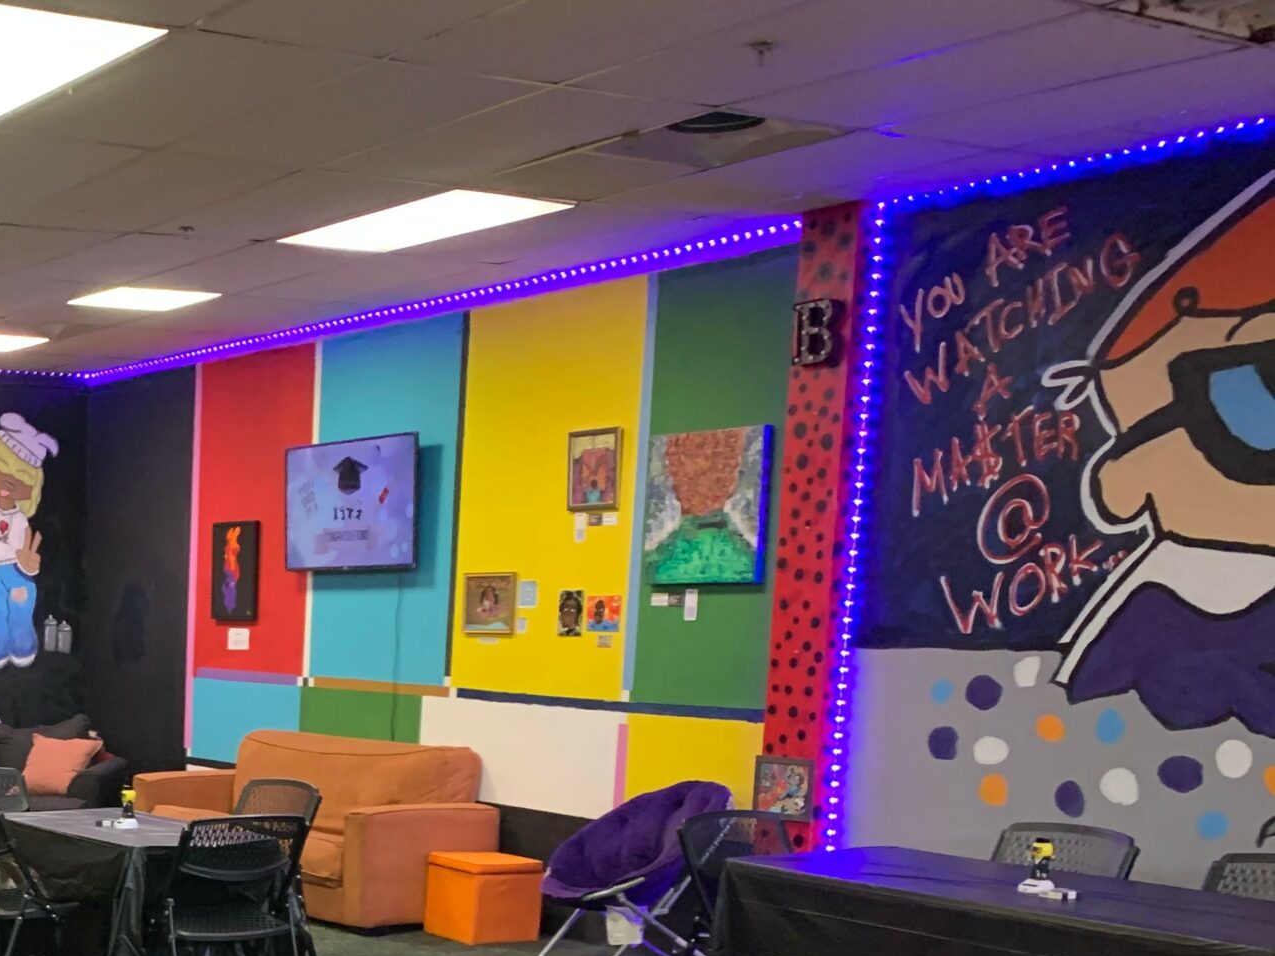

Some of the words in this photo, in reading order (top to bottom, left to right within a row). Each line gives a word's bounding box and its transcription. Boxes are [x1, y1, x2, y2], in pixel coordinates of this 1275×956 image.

[899, 272, 965, 352] YOU
[985, 206, 1071, 288] ARE
[904, 233, 1141, 405] WATCHING
[791, 298, 841, 368] B
[974, 364, 1013, 420] A
[977, 473, 1050, 565] @
